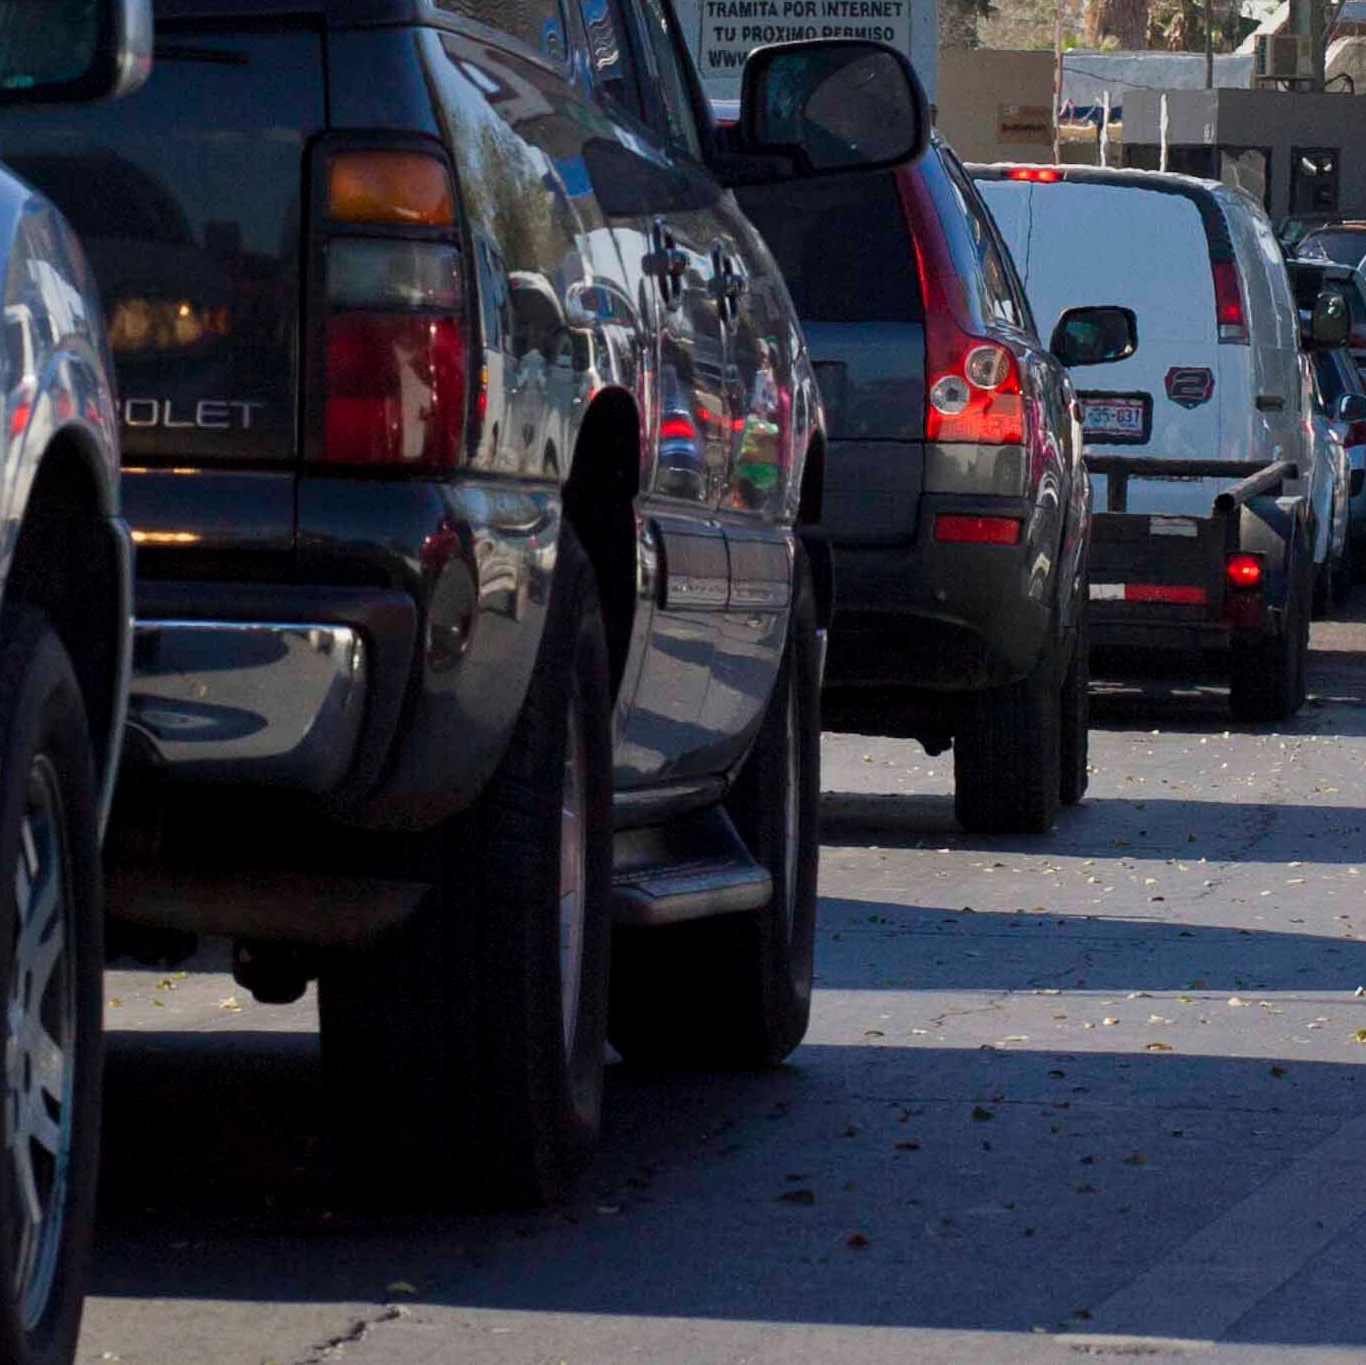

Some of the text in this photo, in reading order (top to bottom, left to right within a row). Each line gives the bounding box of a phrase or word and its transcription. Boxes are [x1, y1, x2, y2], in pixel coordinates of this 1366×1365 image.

[707, 1, 903, 18] TRAMITA POR INTERNET
[714, 25, 734, 42] TU
[742, 25, 818, 42] PROXIMO
[124, 398, 264, 428] OLET
